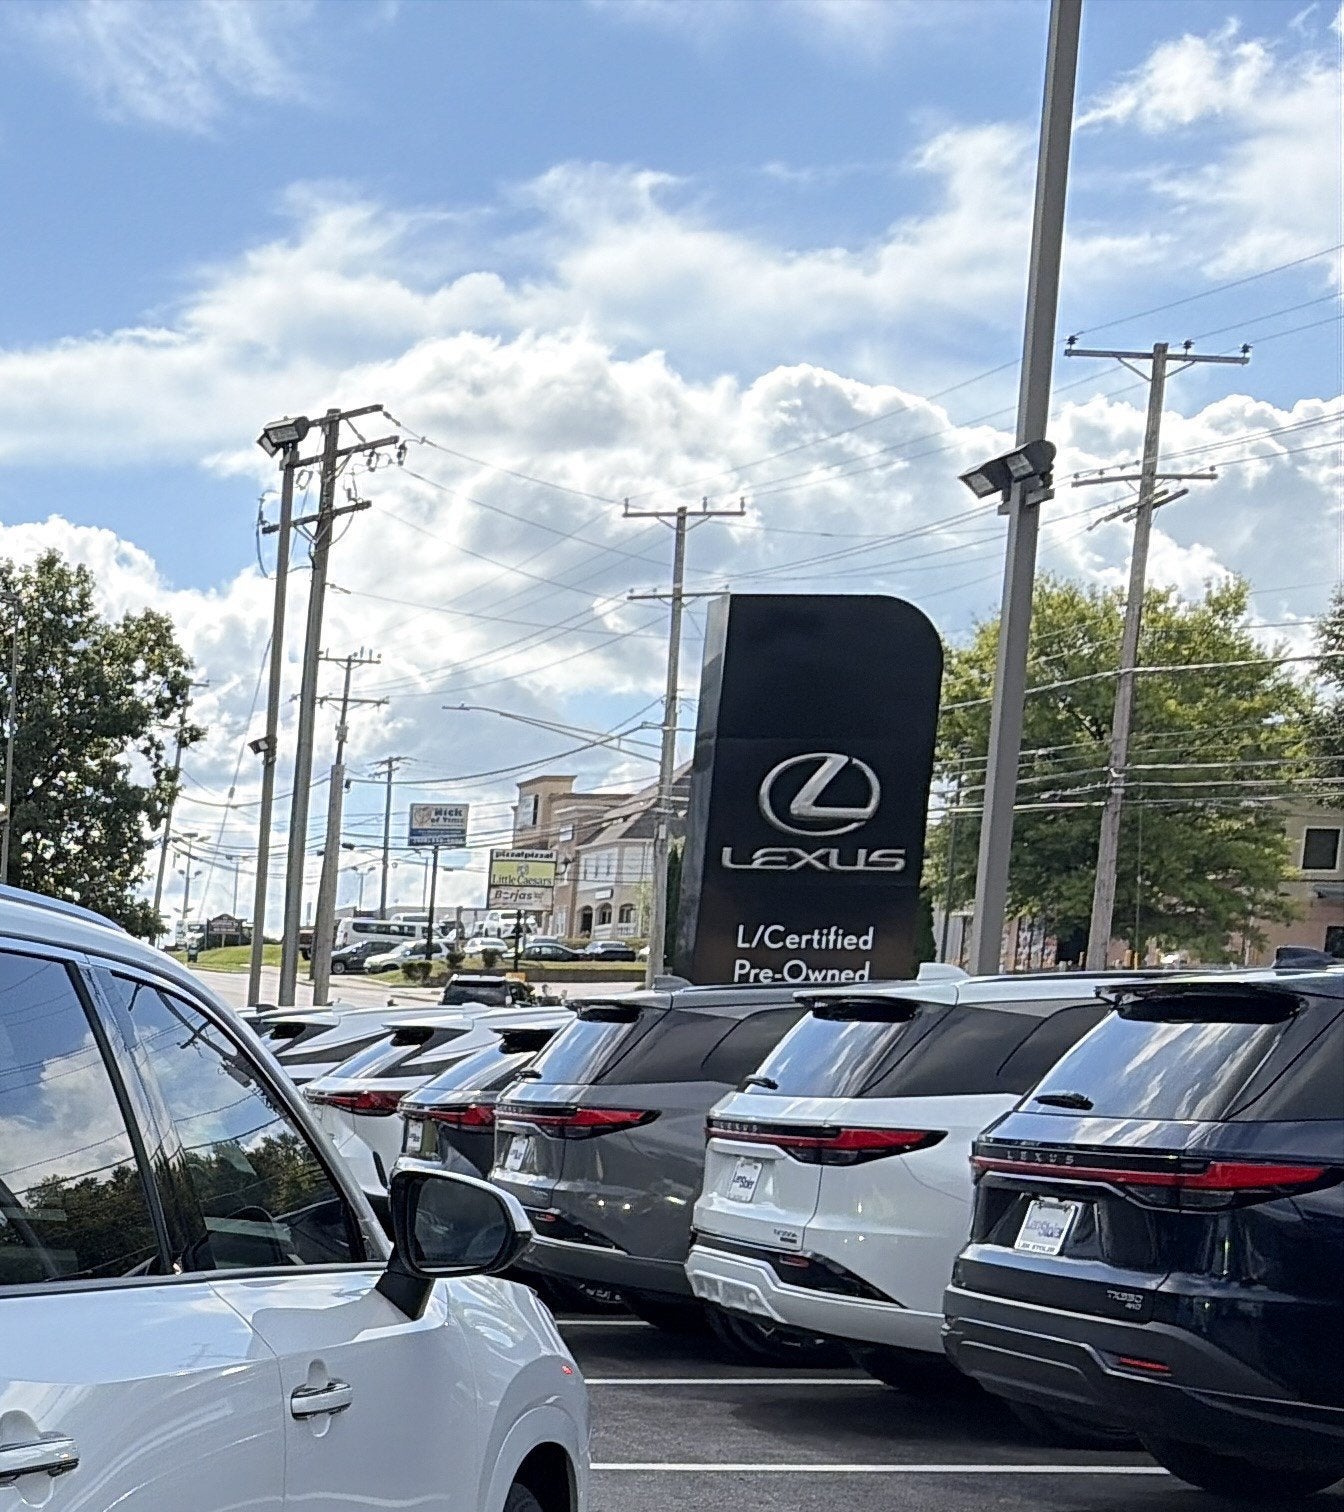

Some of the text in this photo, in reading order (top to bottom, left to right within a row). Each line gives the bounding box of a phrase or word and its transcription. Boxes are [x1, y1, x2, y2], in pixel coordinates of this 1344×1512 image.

[721, 847, 907, 871] LEXUS
[737, 924, 874, 950] L/Certified
[733, 959, 870, 983] Pre-Owned
[1006, 1150, 1075, 1165] LEXUS
